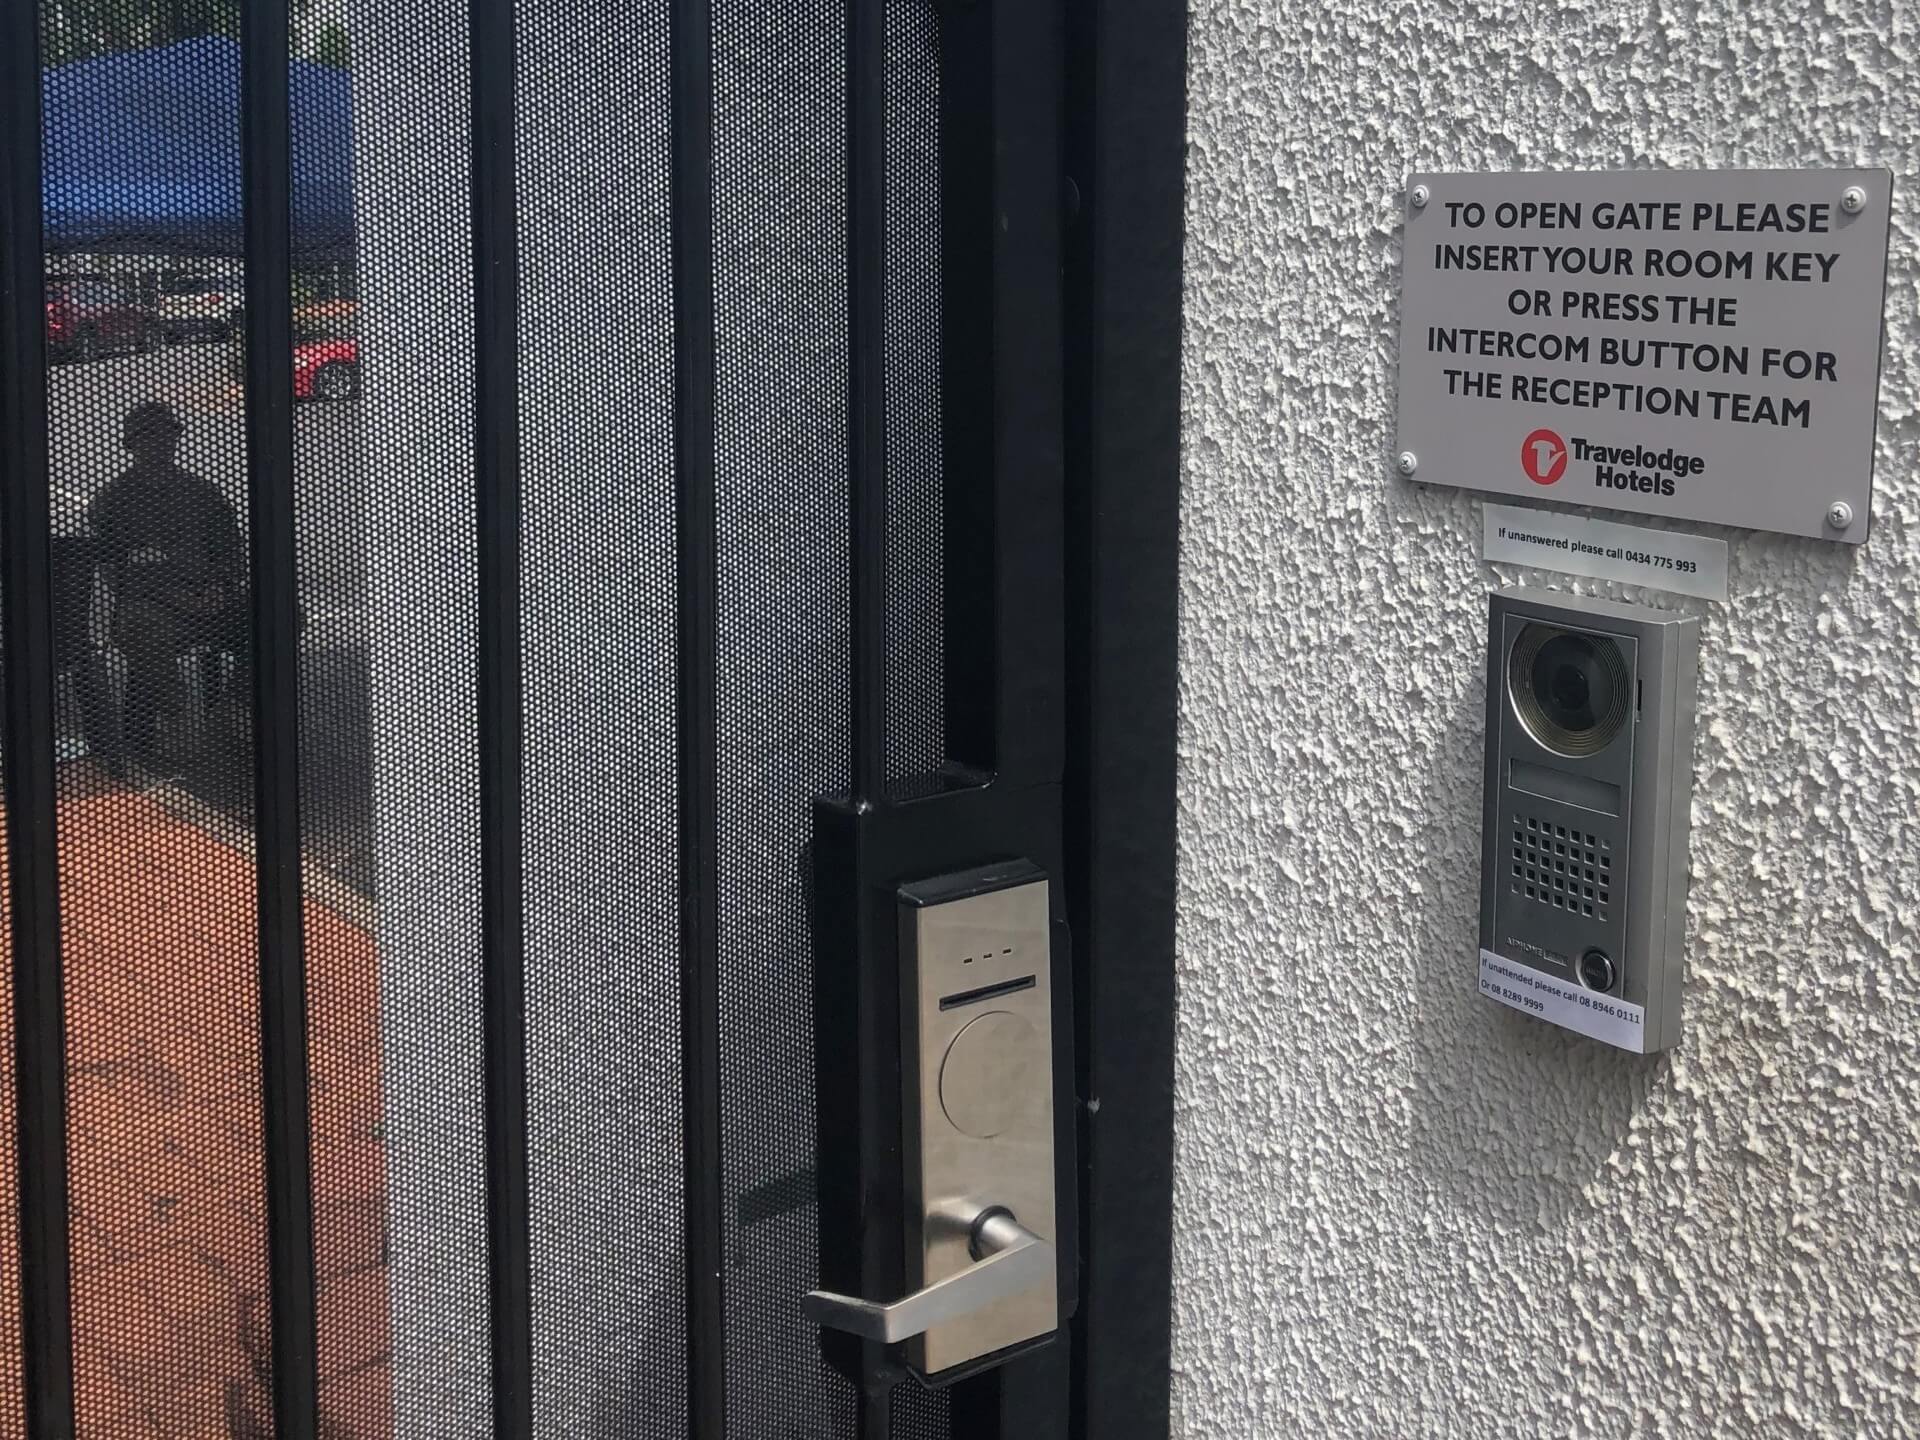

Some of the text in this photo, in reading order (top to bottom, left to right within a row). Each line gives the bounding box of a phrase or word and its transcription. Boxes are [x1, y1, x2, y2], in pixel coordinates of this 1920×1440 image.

[1445, 202, 1830, 233] TO OPEN GATE PLEASE
[1434, 244, 1840, 282] INSERT YOUR ROOM KEY
[1508, 289, 1737, 327] OR PRESS THE
[1428, 327, 1838, 382] INTERCOM BUTTON FOR
[1443, 370, 1810, 428] THE RECEPTION TEAM
[1571, 438, 1705, 478] Travelodge
[1595, 465, 1676, 496] Hotels
[1498, 527, 1697, 574] If unanswered please call 0434 775 993
[1481, 979, 1544, 1012] Or 08 8289 9999
[1482, 958, 1640, 1024] If unattended please call 08 8946 0111
